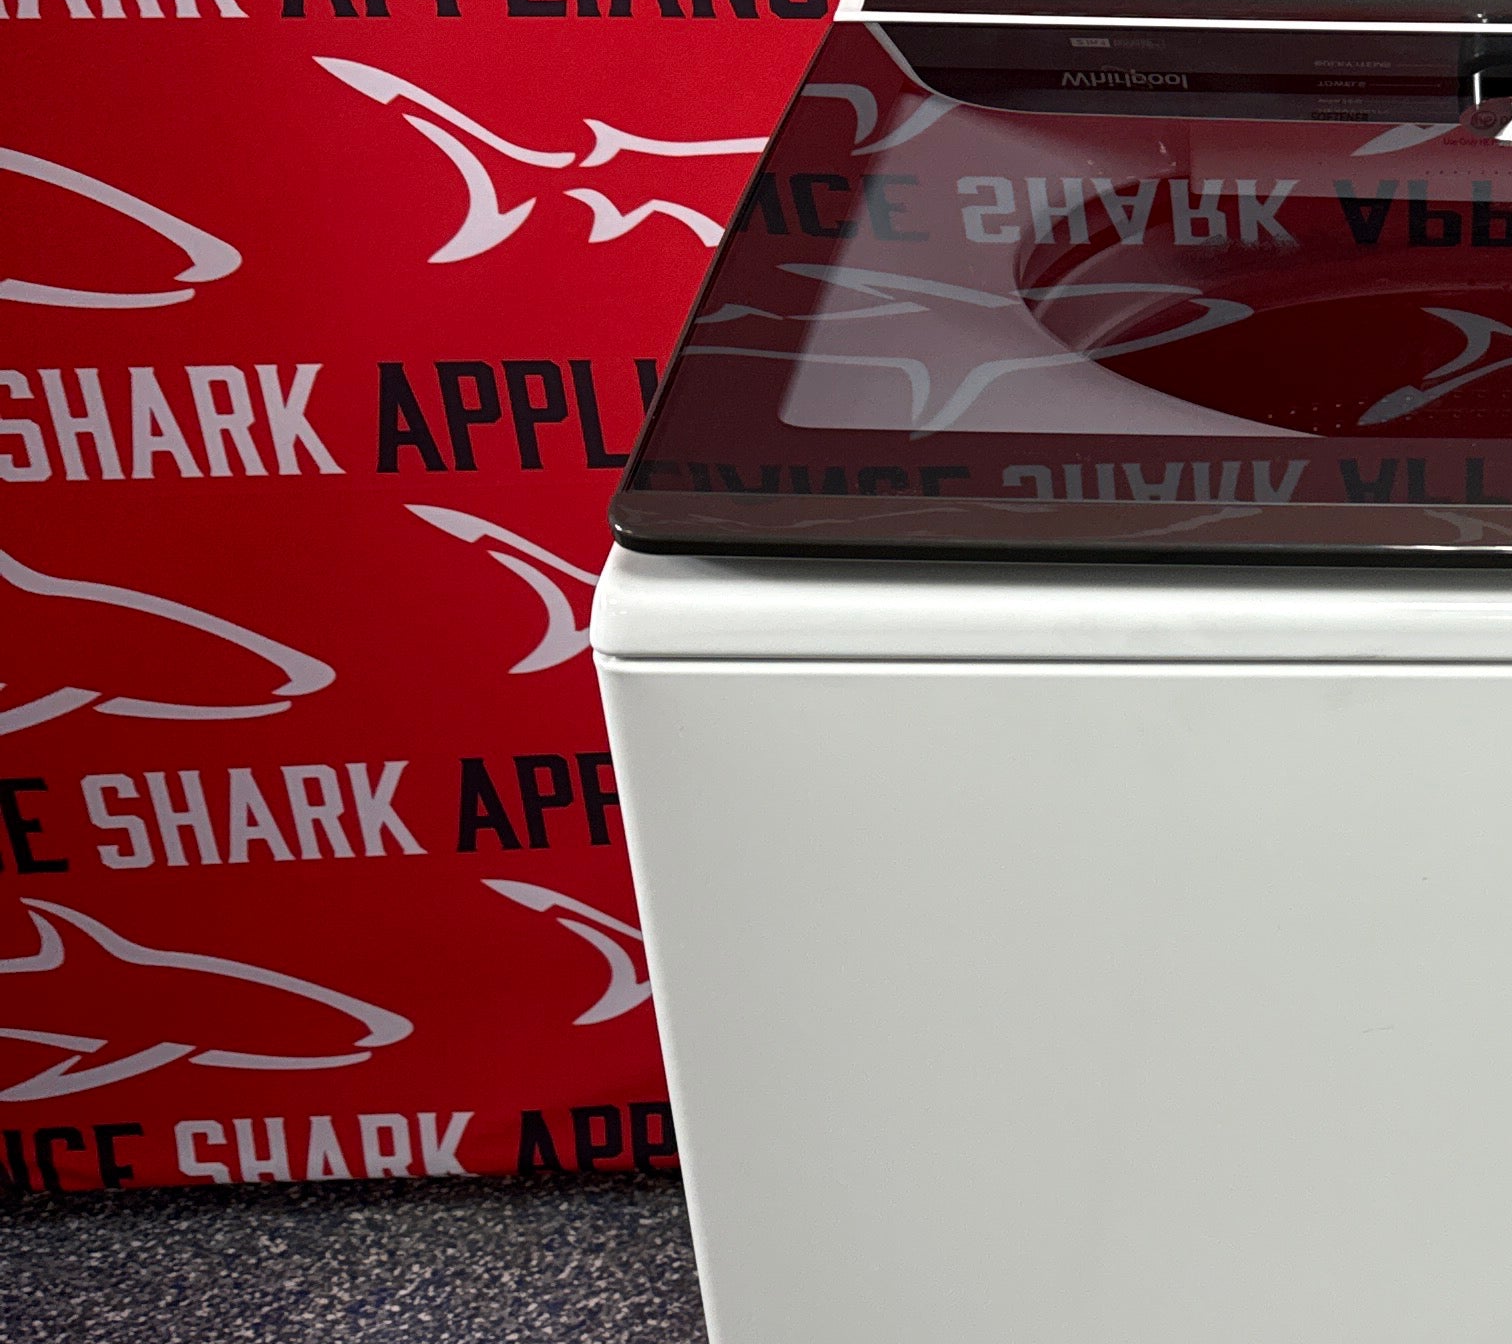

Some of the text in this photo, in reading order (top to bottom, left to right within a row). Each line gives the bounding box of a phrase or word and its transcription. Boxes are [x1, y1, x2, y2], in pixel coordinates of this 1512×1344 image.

[0, 363, 347, 482] SHARK
[0, 777, 70, 875] E
[81, 760, 428, 869] SHARK
